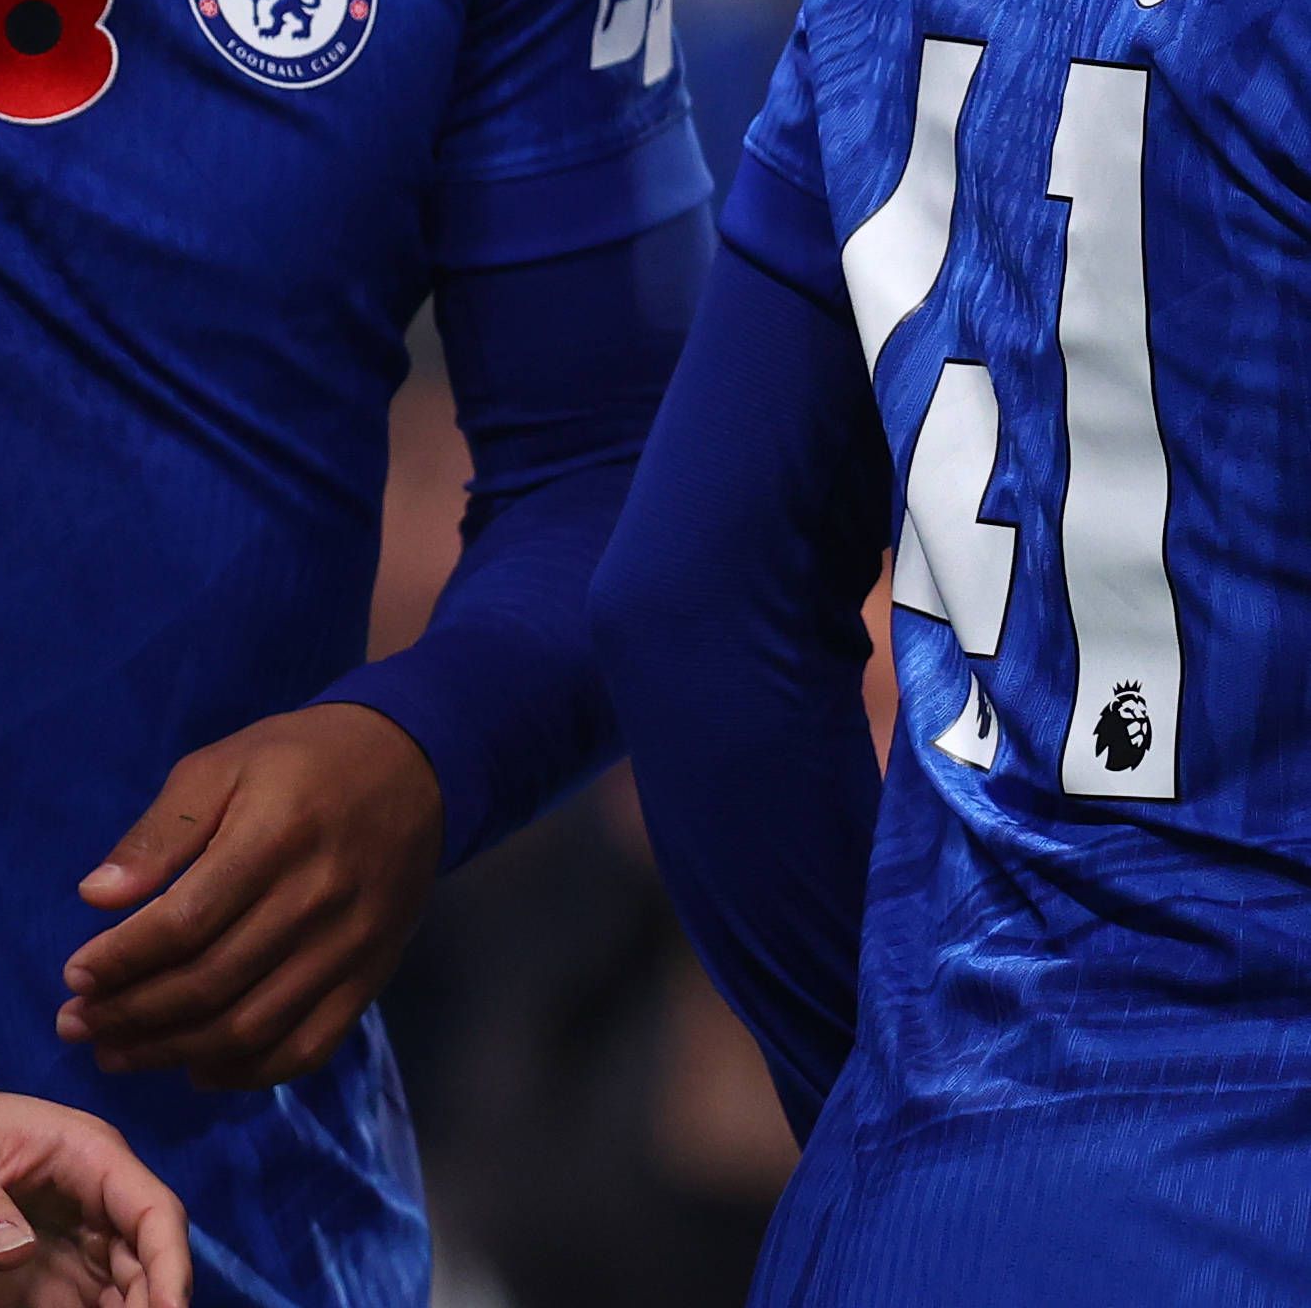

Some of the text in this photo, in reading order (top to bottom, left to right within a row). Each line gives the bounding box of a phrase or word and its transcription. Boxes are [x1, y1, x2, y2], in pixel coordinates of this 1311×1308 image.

[227, 39, 347, 77] FOOTBALL CLUB
[841, 34, 1182, 801] 41
